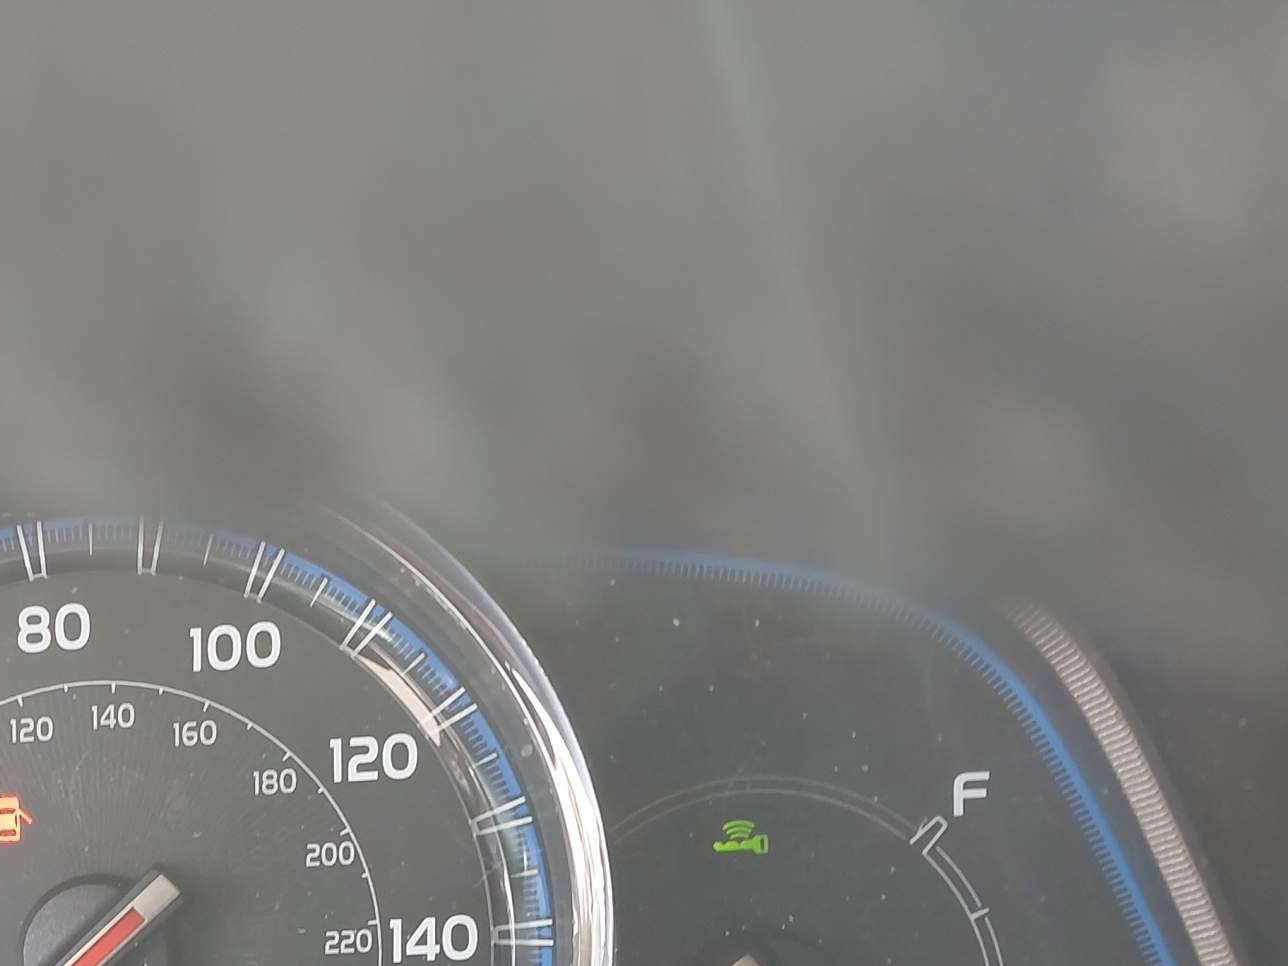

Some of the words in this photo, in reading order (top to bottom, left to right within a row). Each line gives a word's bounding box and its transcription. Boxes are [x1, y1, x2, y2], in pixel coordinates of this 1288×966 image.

[17, 602, 91, 654] 80
[189, 621, 282, 672] 100
[91, 702, 135, 730] 140
[9, 717, 54, 745] 120
[173, 719, 218, 747] 160
[329, 733, 419, 783] 120
[253, 768, 298, 796] 180
[953, 771, 990, 817] F
[306, 841, 356, 868] 200
[324, 929, 373, 956] 220
[390, 916, 478, 962] 140
